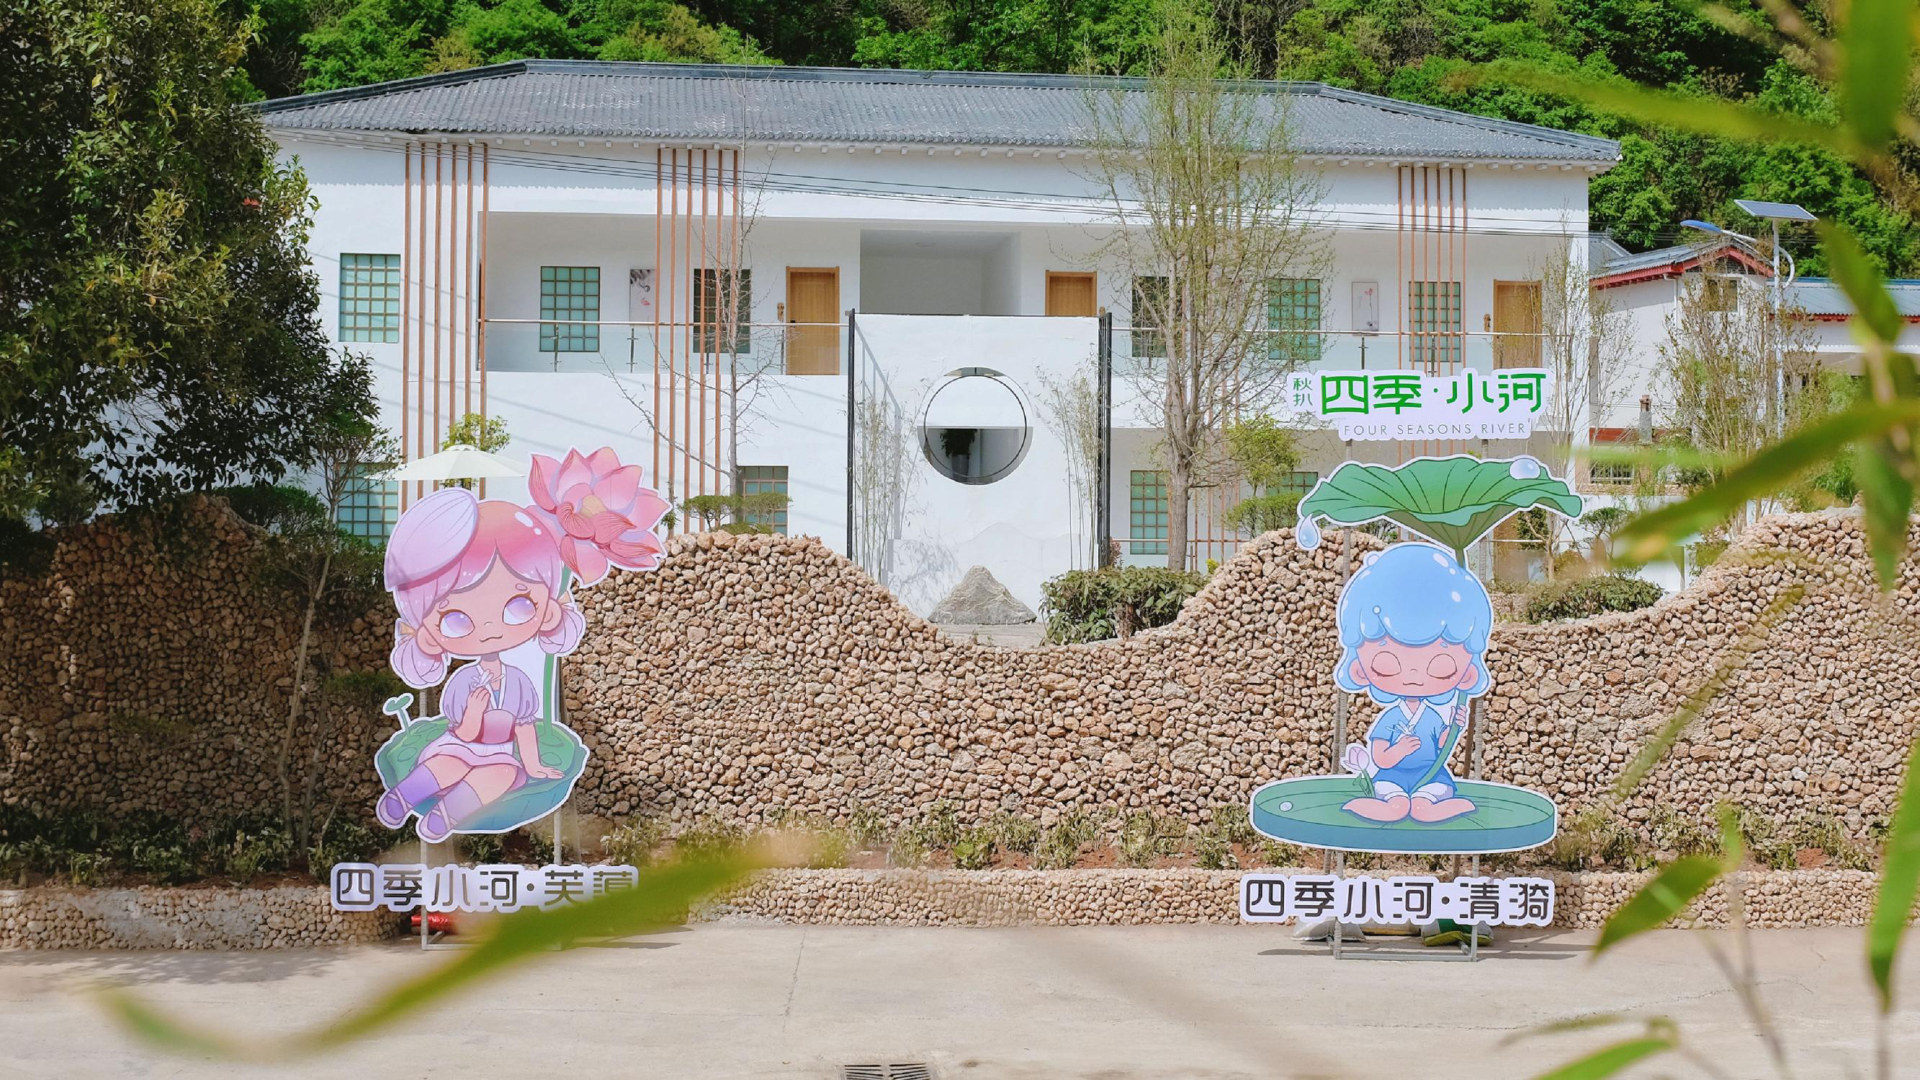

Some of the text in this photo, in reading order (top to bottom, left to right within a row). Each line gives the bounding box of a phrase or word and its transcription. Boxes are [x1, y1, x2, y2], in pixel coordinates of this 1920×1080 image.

[1344, 422, 1525, 436] FOUR SEASONS RIVER
